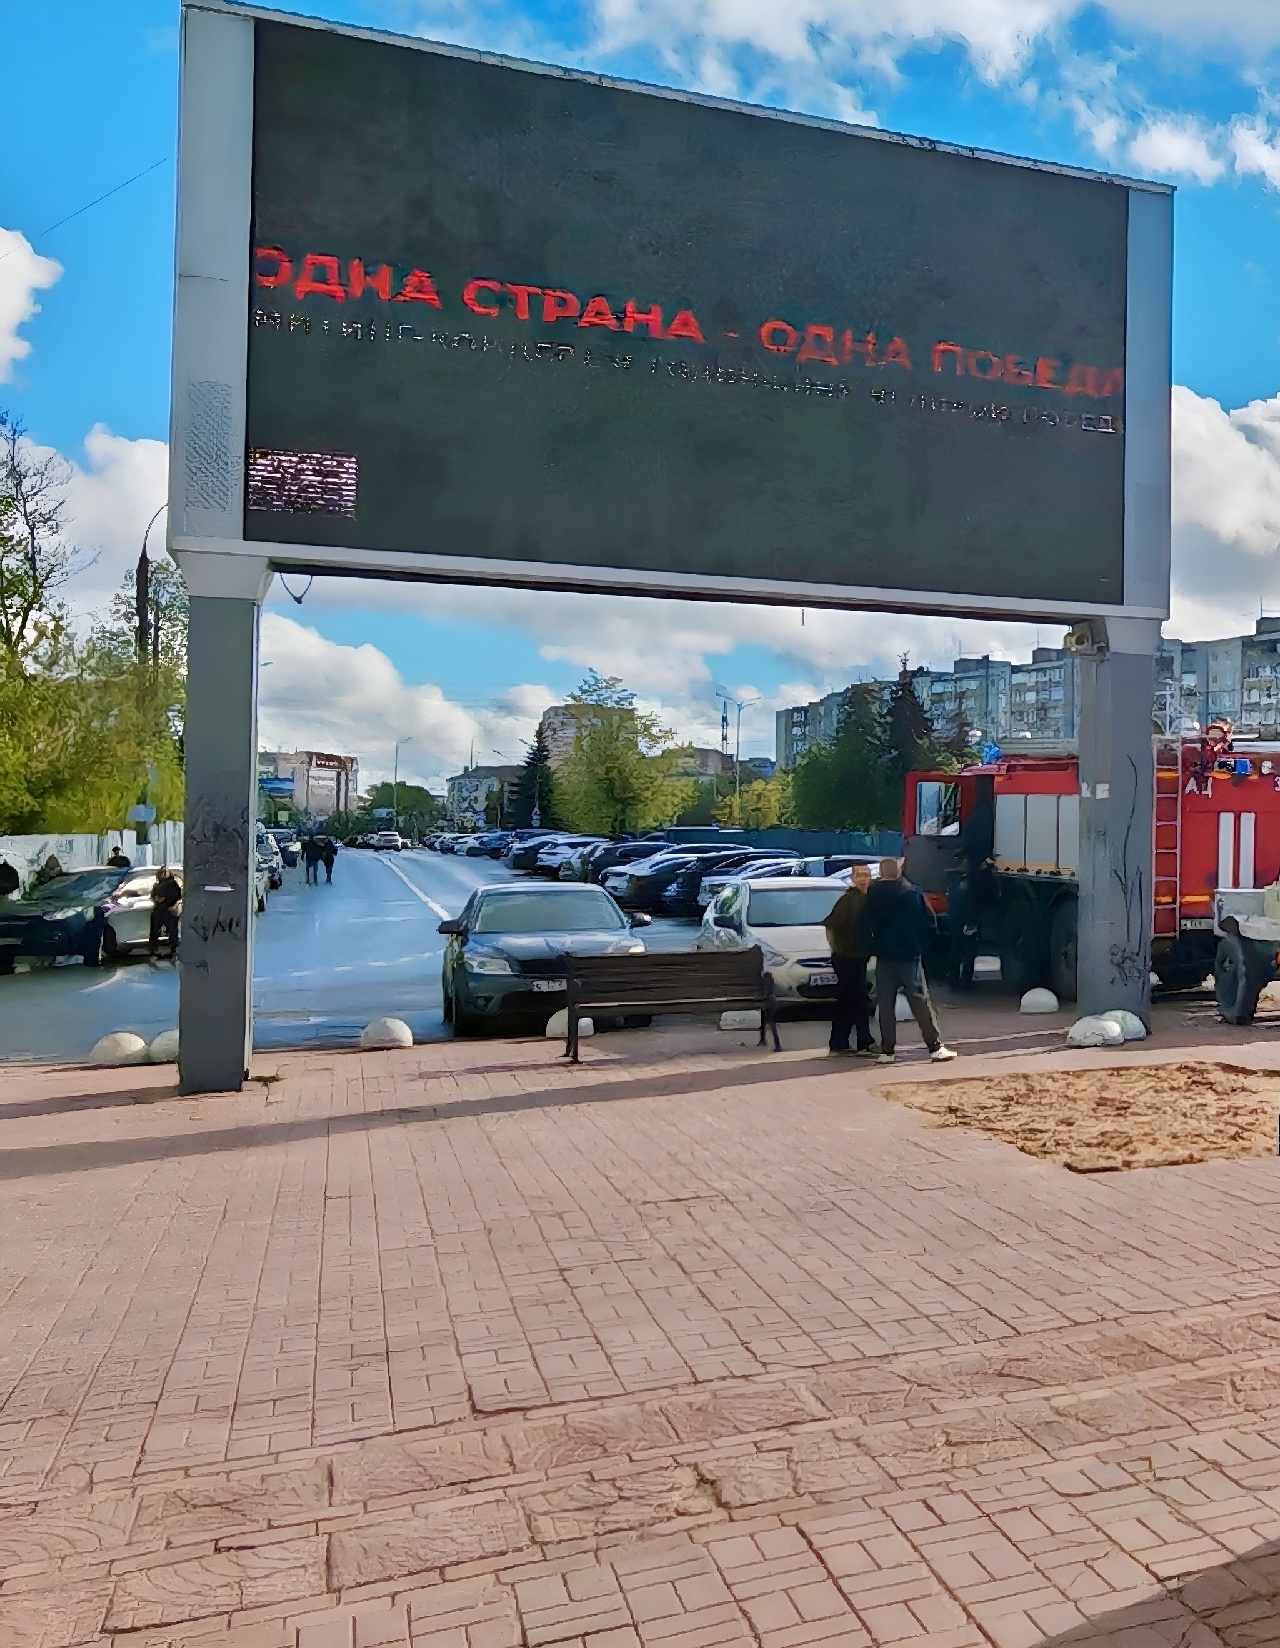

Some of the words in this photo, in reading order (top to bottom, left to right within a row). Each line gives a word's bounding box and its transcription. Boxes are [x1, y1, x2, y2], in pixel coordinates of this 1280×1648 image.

[254, 245, 442, 310] ОДНА
[462, 277, 705, 344] СТРАНА
[757, 318, 911, 371] ОДНА
